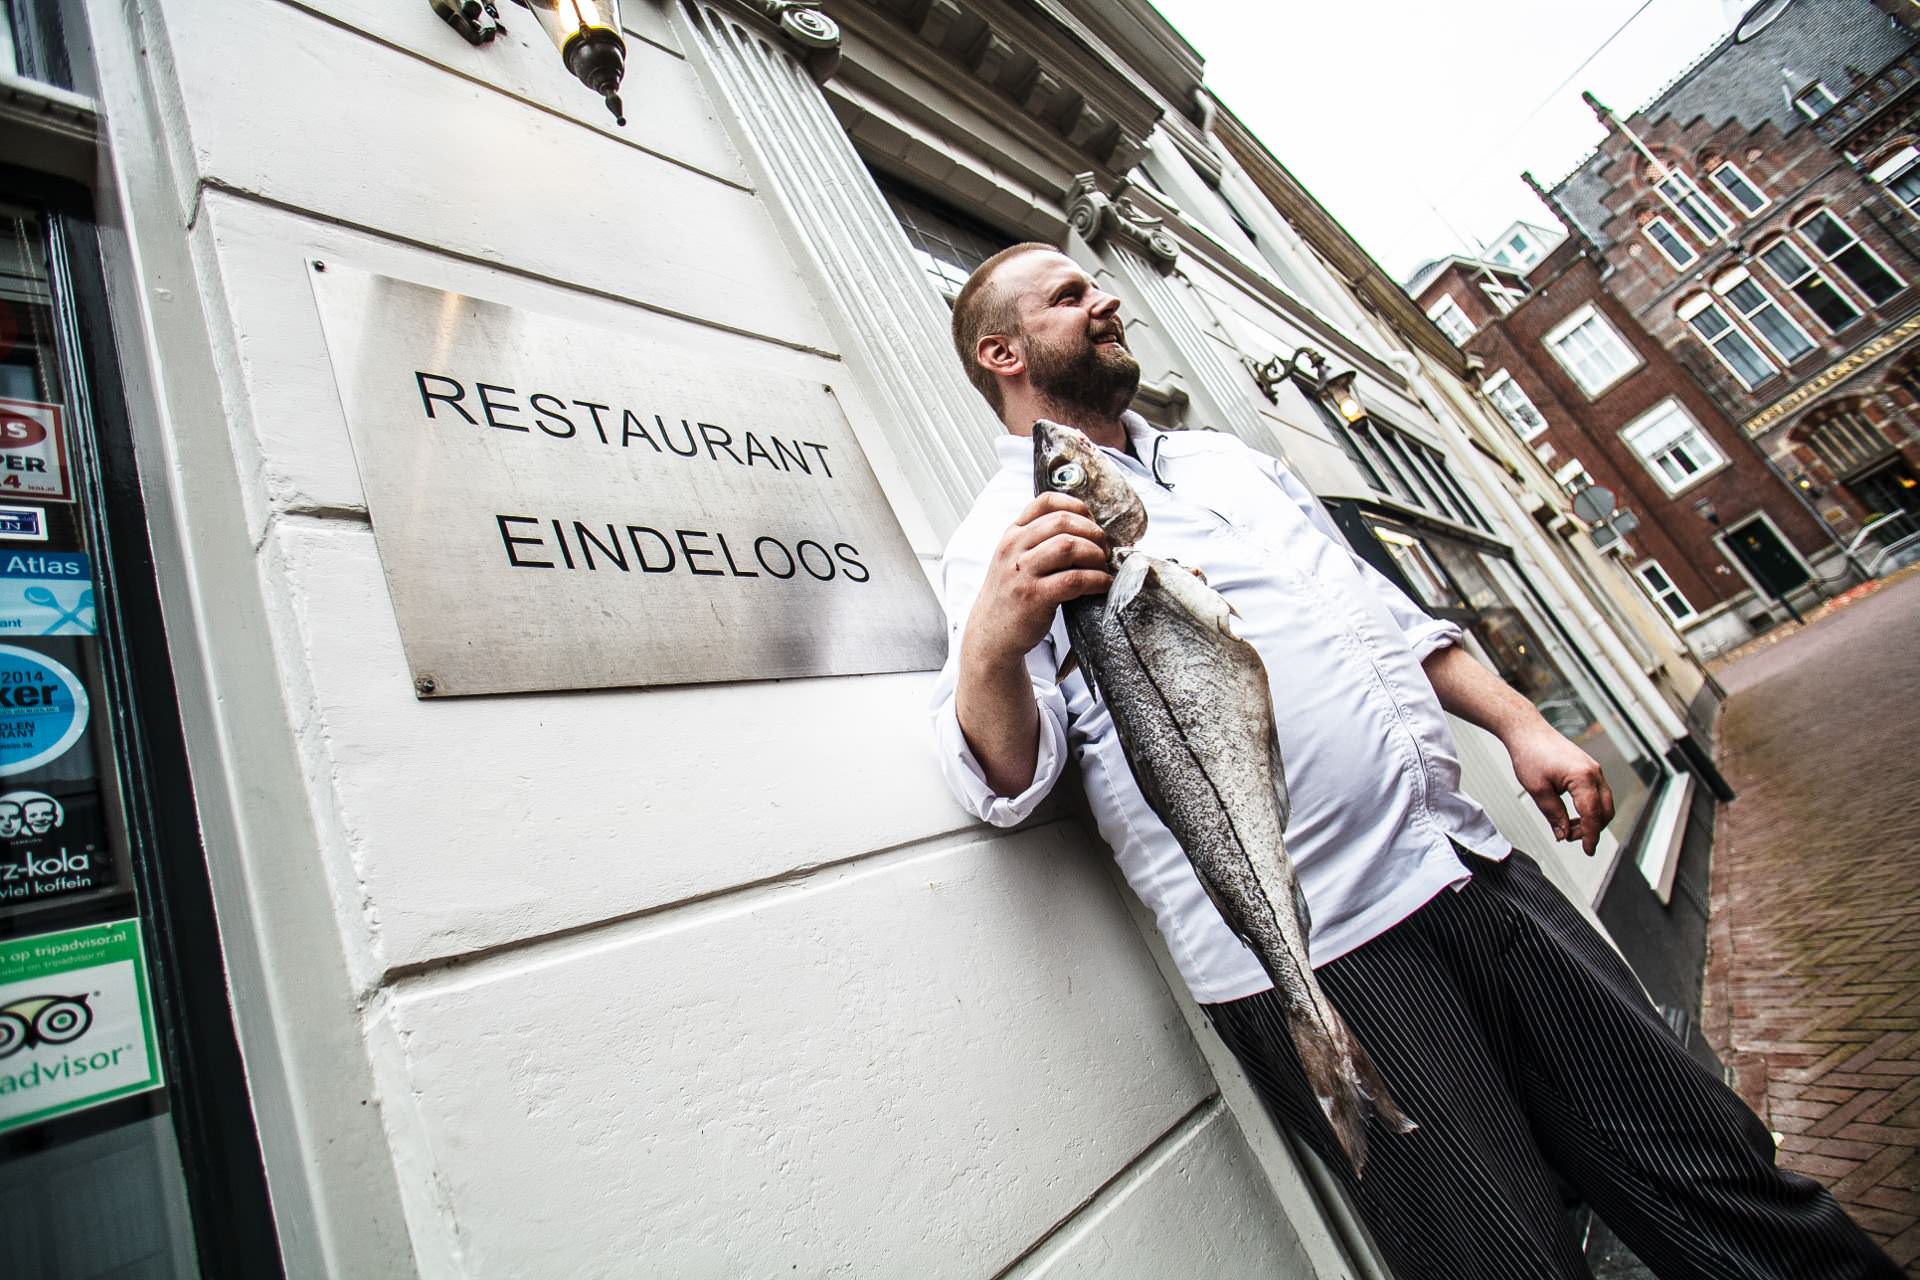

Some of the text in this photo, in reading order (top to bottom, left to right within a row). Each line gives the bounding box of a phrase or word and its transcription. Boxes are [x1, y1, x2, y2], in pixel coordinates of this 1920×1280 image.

[414, 371, 833, 479] RESTAURANT
[497, 515, 871, 583] EINDELOOS
[6, 555, 81, 575] Atlas
[1, 671, 44, 684] 2014
[35, 875, 92, 895] koffein
[10, 951, 31, 963] op
[35, 930, 127, 957] tripadvisor.nl
